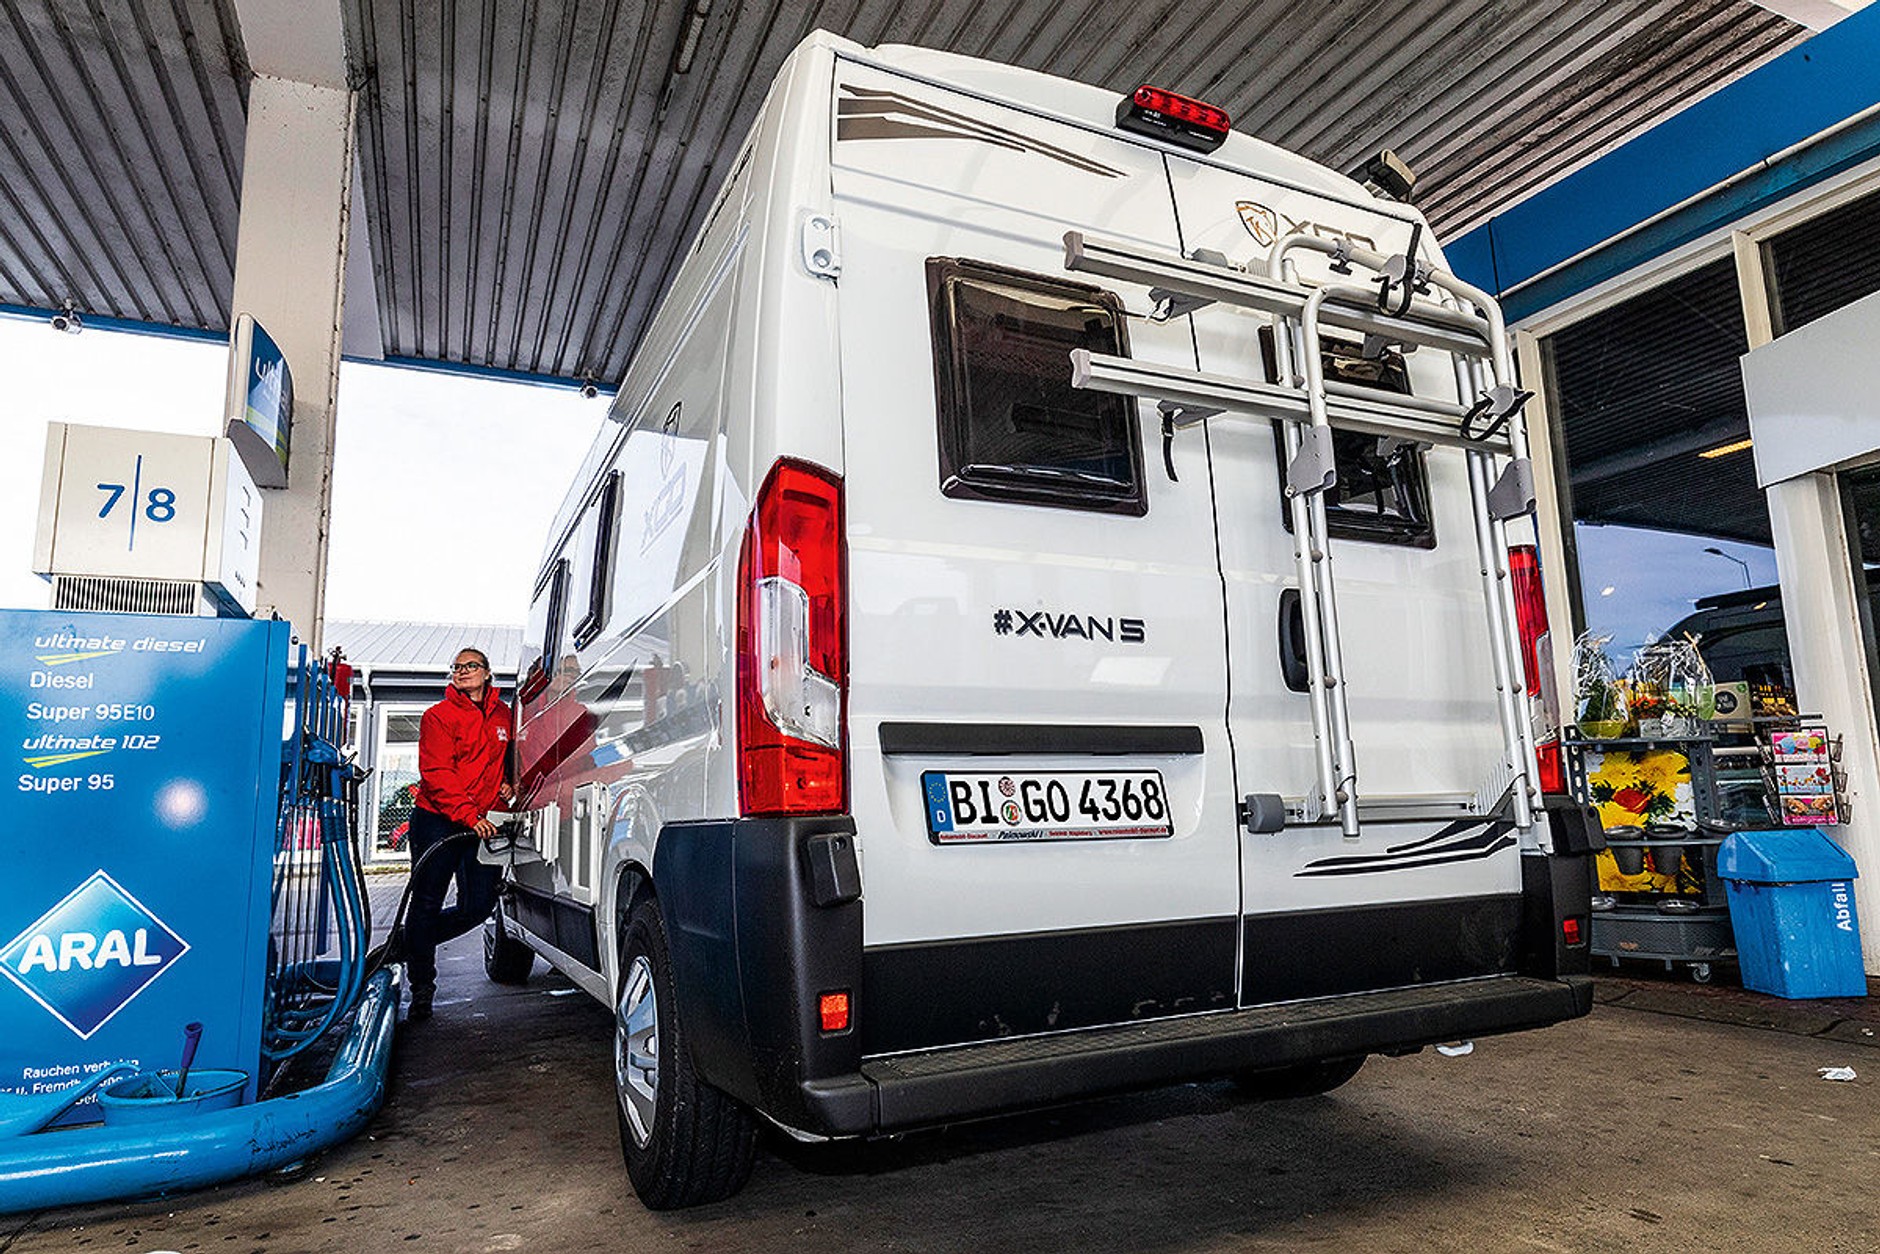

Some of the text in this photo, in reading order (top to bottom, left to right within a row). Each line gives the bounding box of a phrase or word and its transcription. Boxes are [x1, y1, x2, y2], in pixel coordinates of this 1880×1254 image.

[96, 483, 177, 523] 7 8
[34, 632, 206, 654] ultimate diesel
[29, 670, 95, 690] Diesel
[26, 702, 91, 723] Super
[22, 733, 161, 750] ultimate 102
[17, 774, 115, 795] Super 95
[949, 779, 1165, 825] BI GO 4368
[936, 809, 946, 823] D
[1831, 882, 1853, 932] Abfall
[17, 927, 162, 975] ARAL
[23, 1064, 80, 1080] Rauchen
